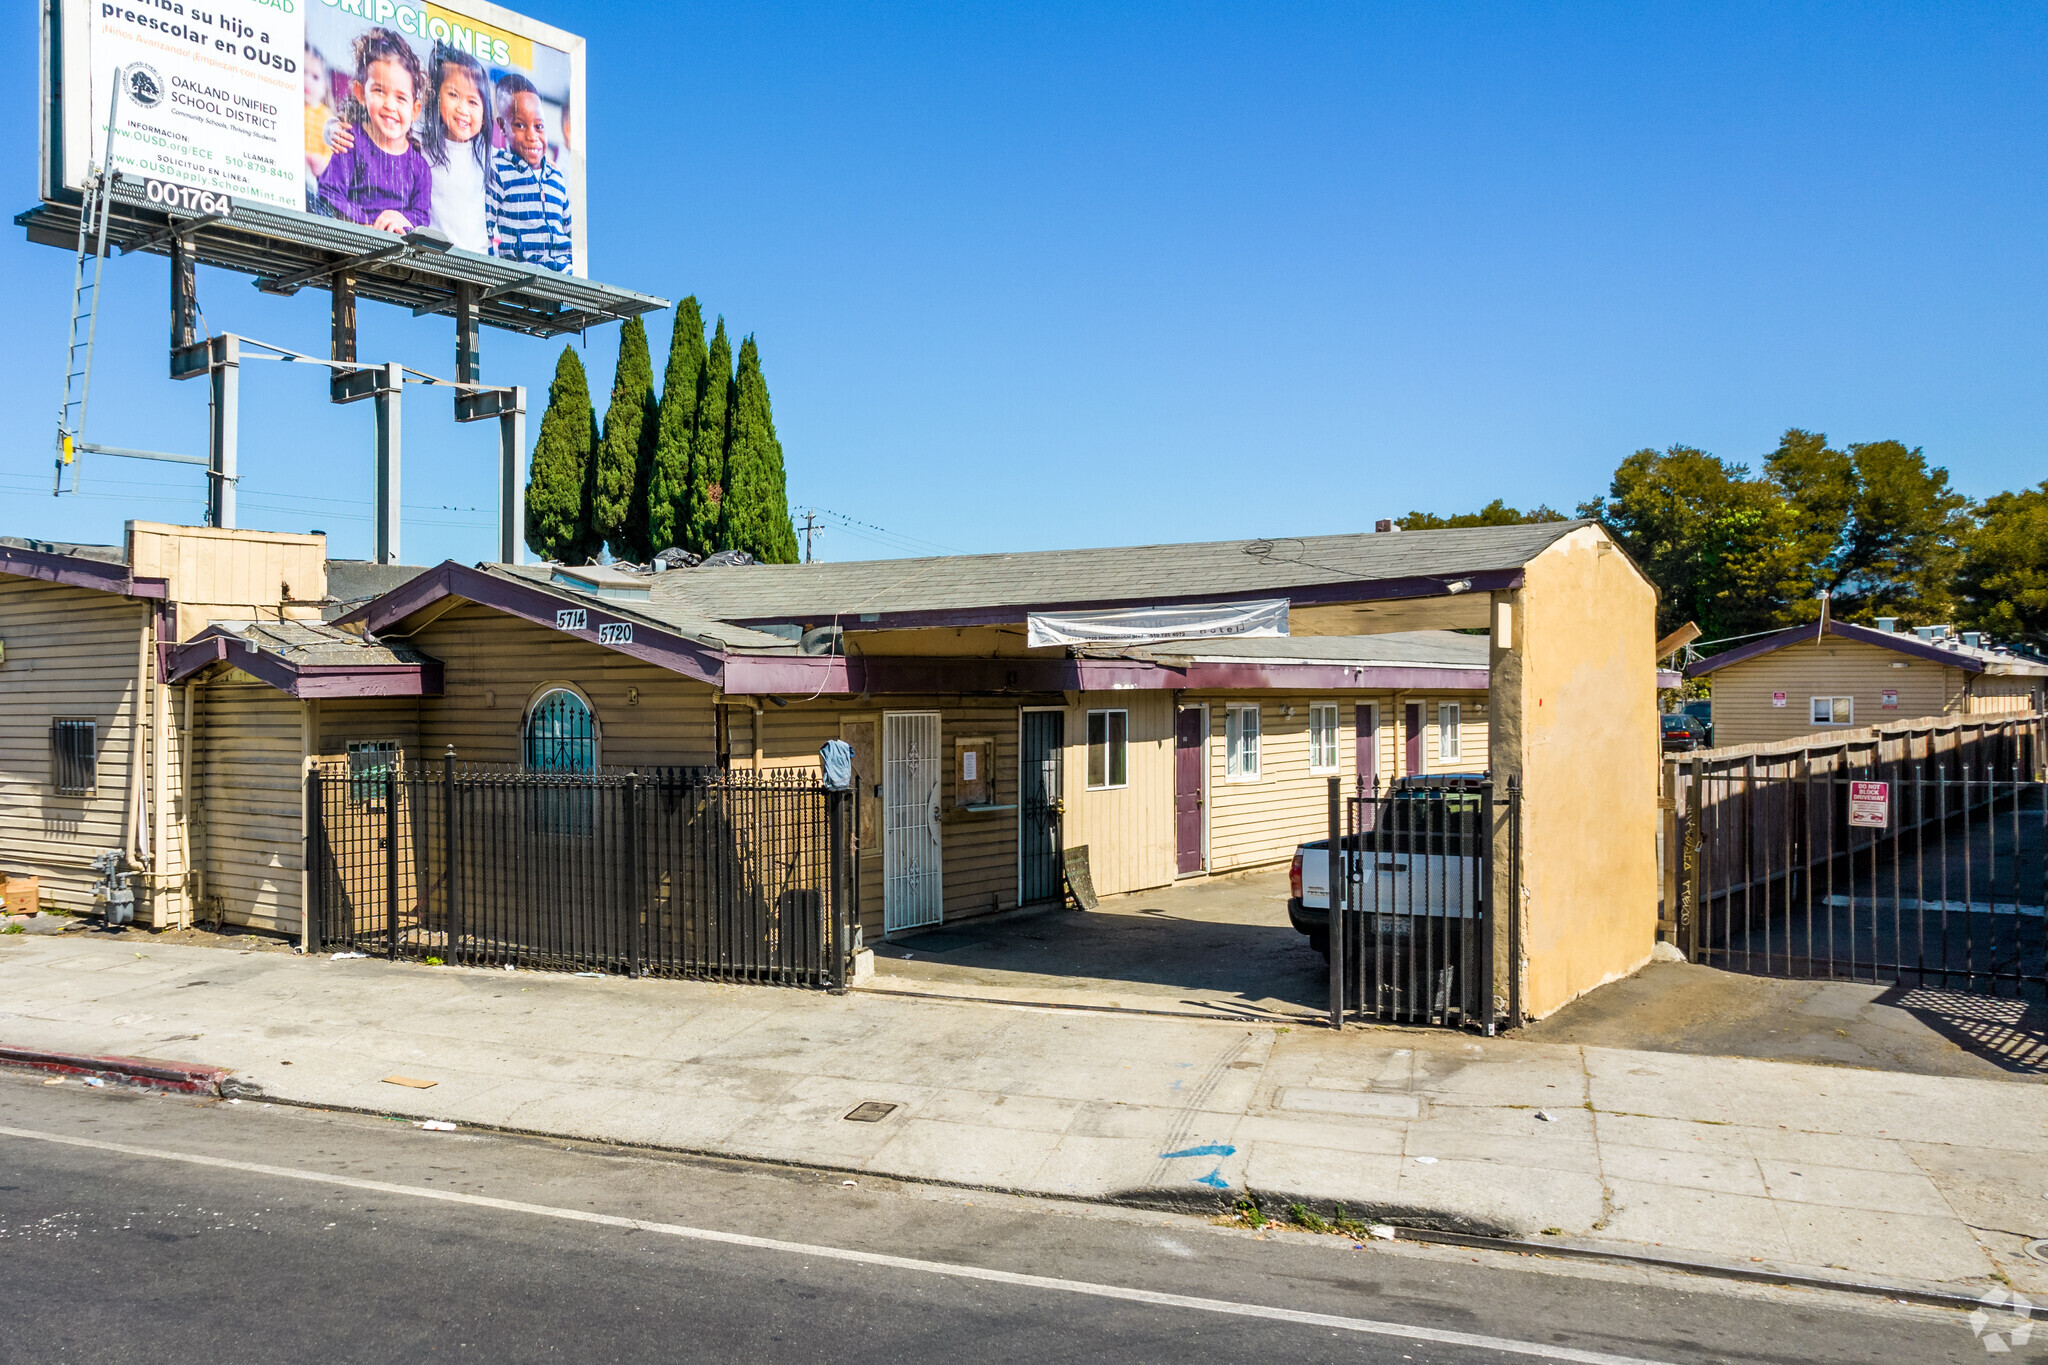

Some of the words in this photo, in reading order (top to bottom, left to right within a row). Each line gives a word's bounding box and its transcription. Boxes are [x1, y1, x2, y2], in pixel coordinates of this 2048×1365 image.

[102, 3, 208, 45] preescolar
[215, 39, 236, 55] en
[243, 45, 296, 73] OUSD
[191, 9, 212, 25] su
[220, 14, 254, 38] hijo
[260, 32, 270, 44] a
[240, 68, 256, 79] con
[258, 74, 297, 91] nosotros!
[171, 76, 230, 101] OAKLAND
[233, 94, 278, 116] UNIFIED
[171, 91, 222, 115] SCHOOL
[225, 107, 277, 130] DISTRICT
[171, 108, 204, 123] Community
[230, 124, 252, 137] Thriving
[253, 131, 277, 143] Students
[157, 154, 206, 172] SOLICITUD
[208, 167, 220, 176] EN
[225, 155, 294, 181] 510-879-8410
[243, 151, 276, 166] LLAMAR:
[147, 180, 230, 216] 001764
[557, 610, 586, 628] 5714
[600, 624, 632, 643] 5720
